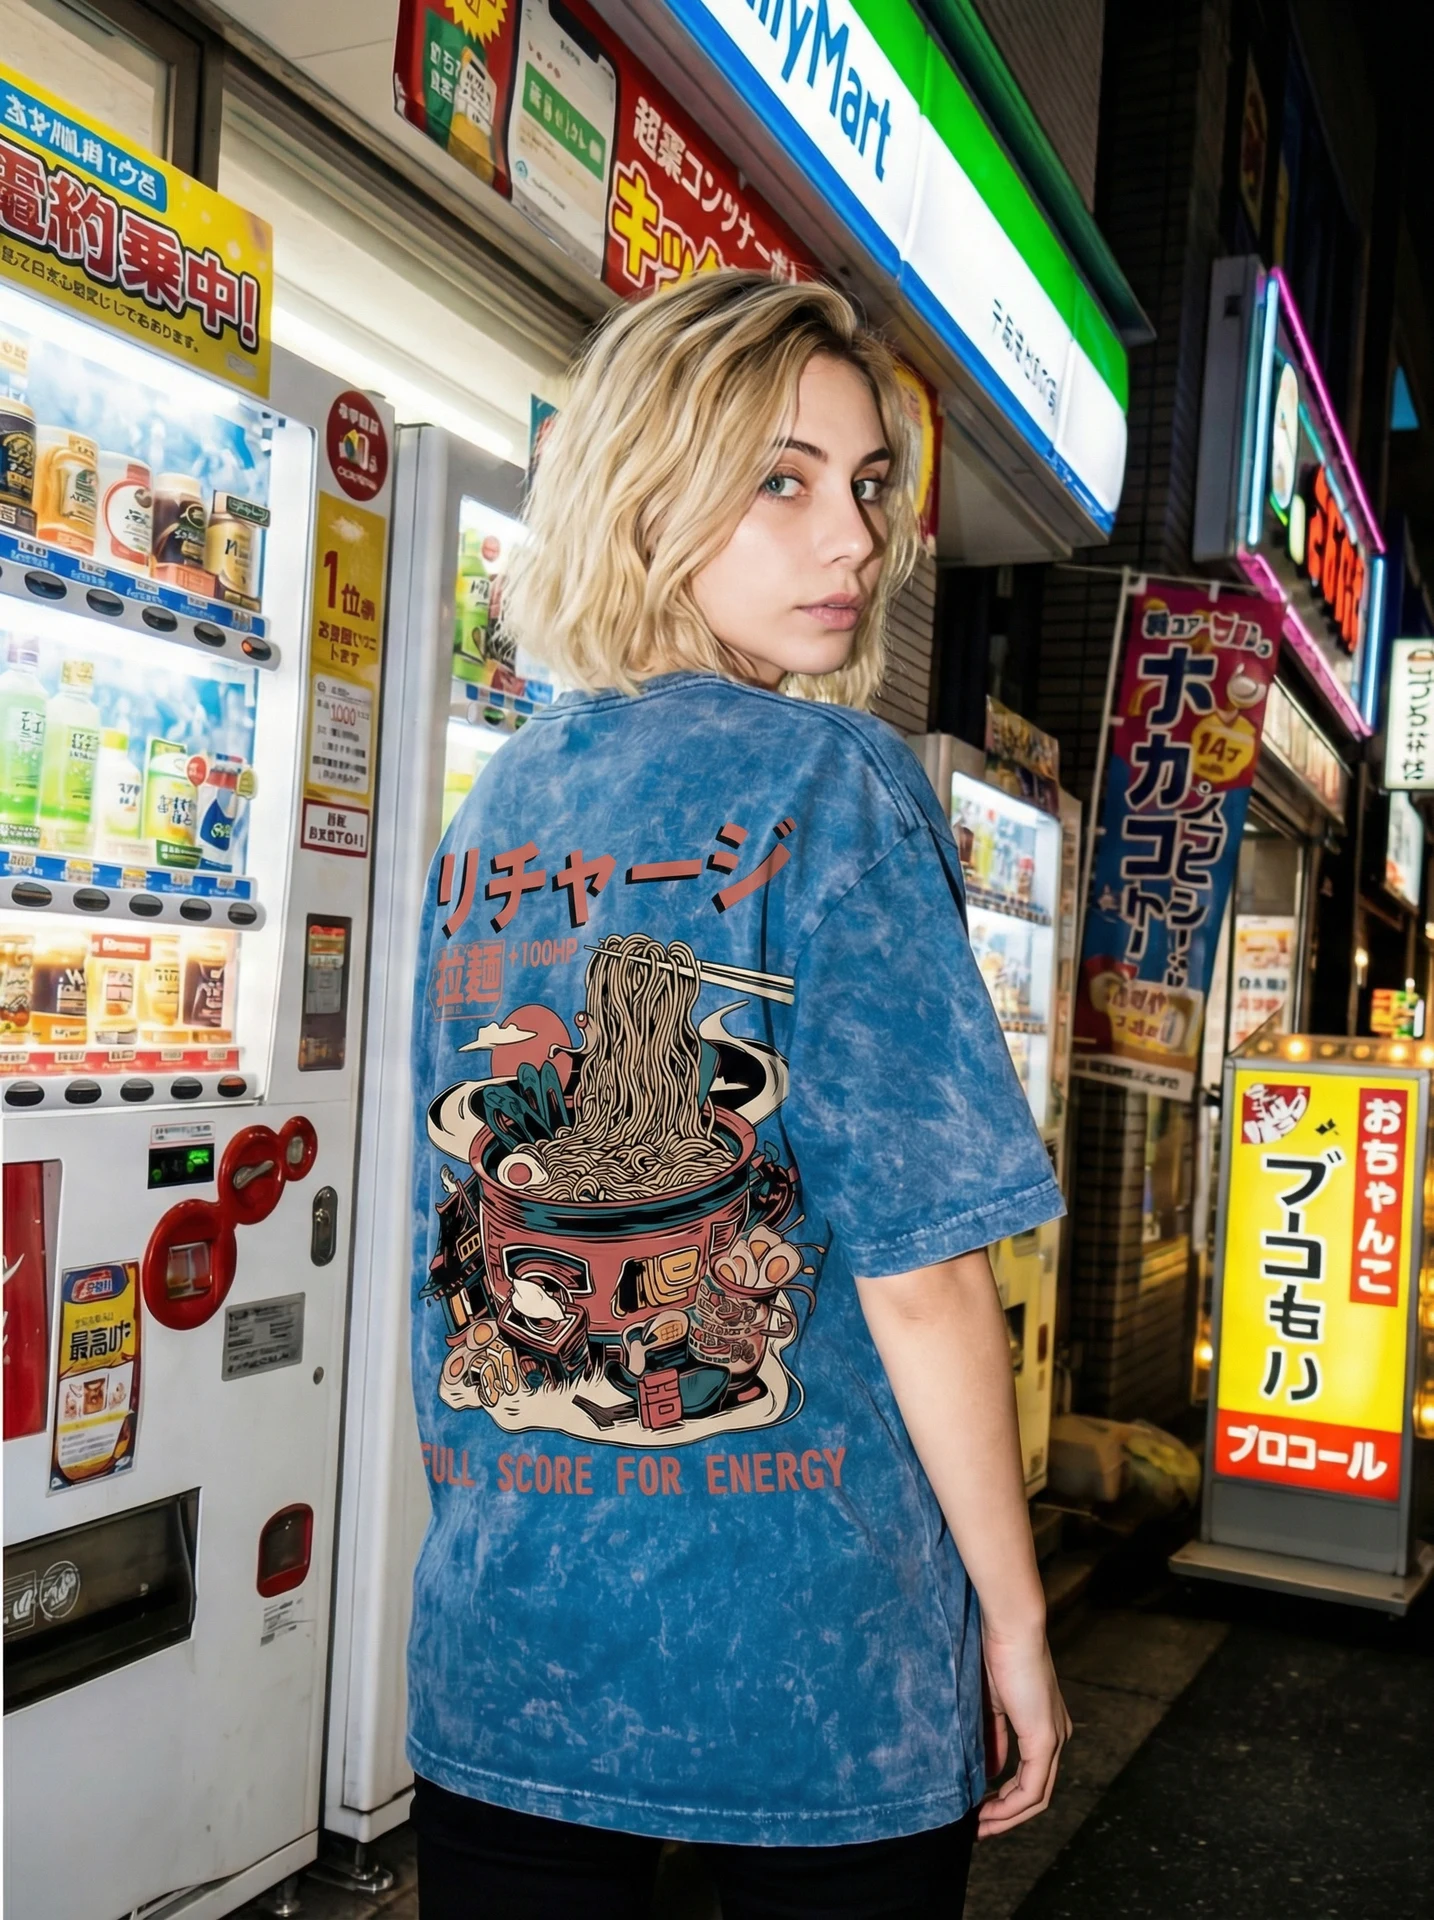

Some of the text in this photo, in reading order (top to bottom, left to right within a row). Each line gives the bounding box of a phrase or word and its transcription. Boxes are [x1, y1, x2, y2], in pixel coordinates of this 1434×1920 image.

[437, 817, 797, 940] リチャージ
[499, 1454, 594, 1495] SCORE
[617, 1456, 682, 1495] FOR
[705, 1447, 847, 1495] ENERGY
